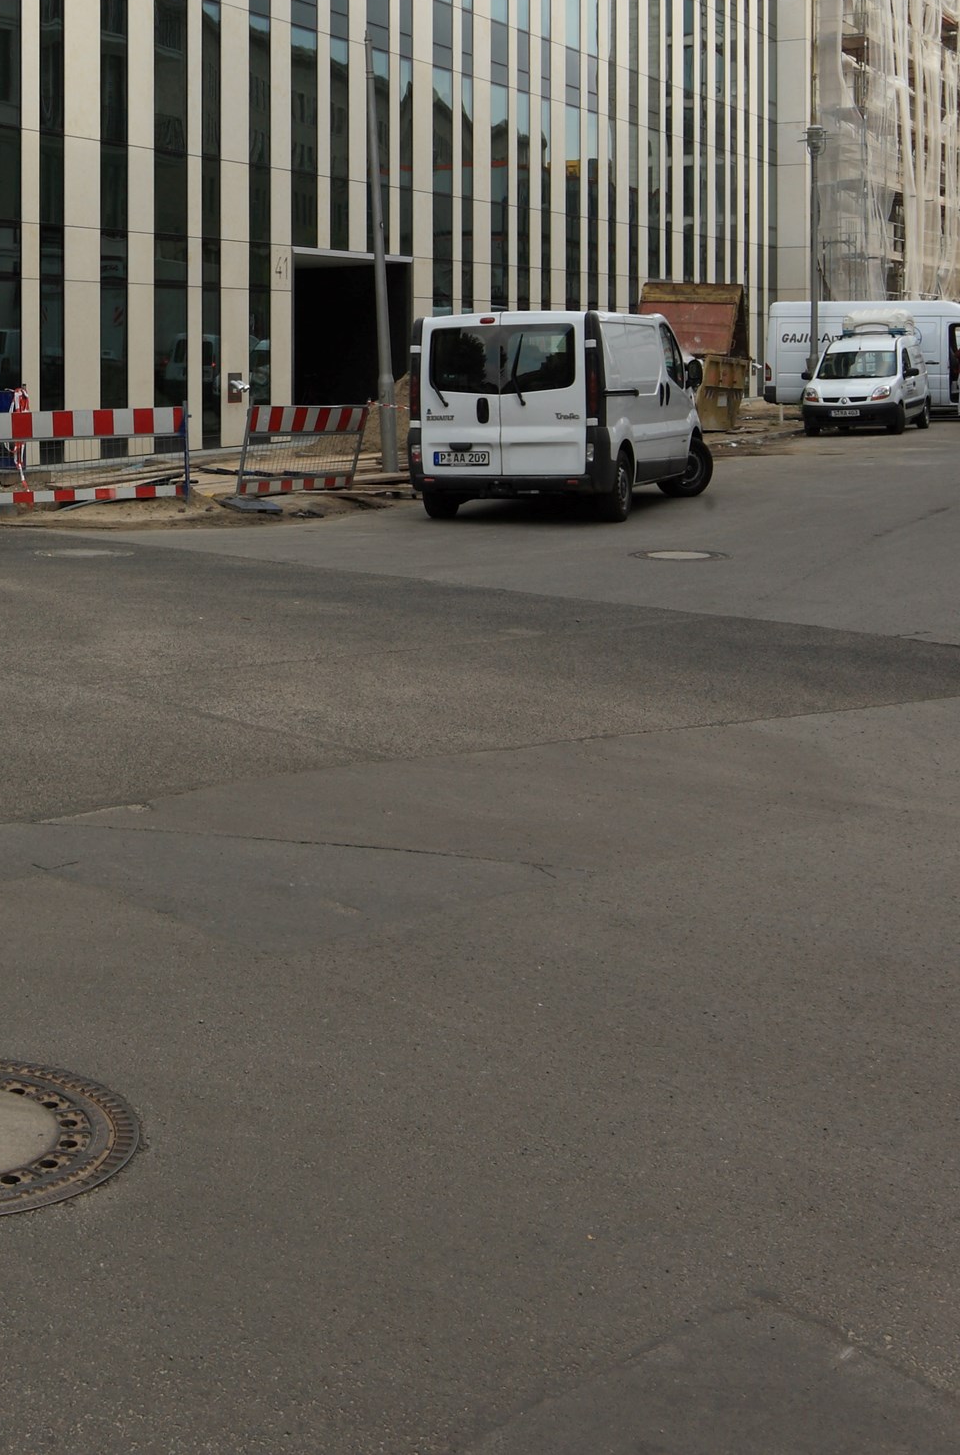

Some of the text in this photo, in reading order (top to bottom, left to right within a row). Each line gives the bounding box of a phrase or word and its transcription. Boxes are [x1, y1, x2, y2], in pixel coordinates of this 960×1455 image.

[274, 256, 289, 280] 41
[453, 453, 466, 463] AA
[468, 453, 487, 463] 209
